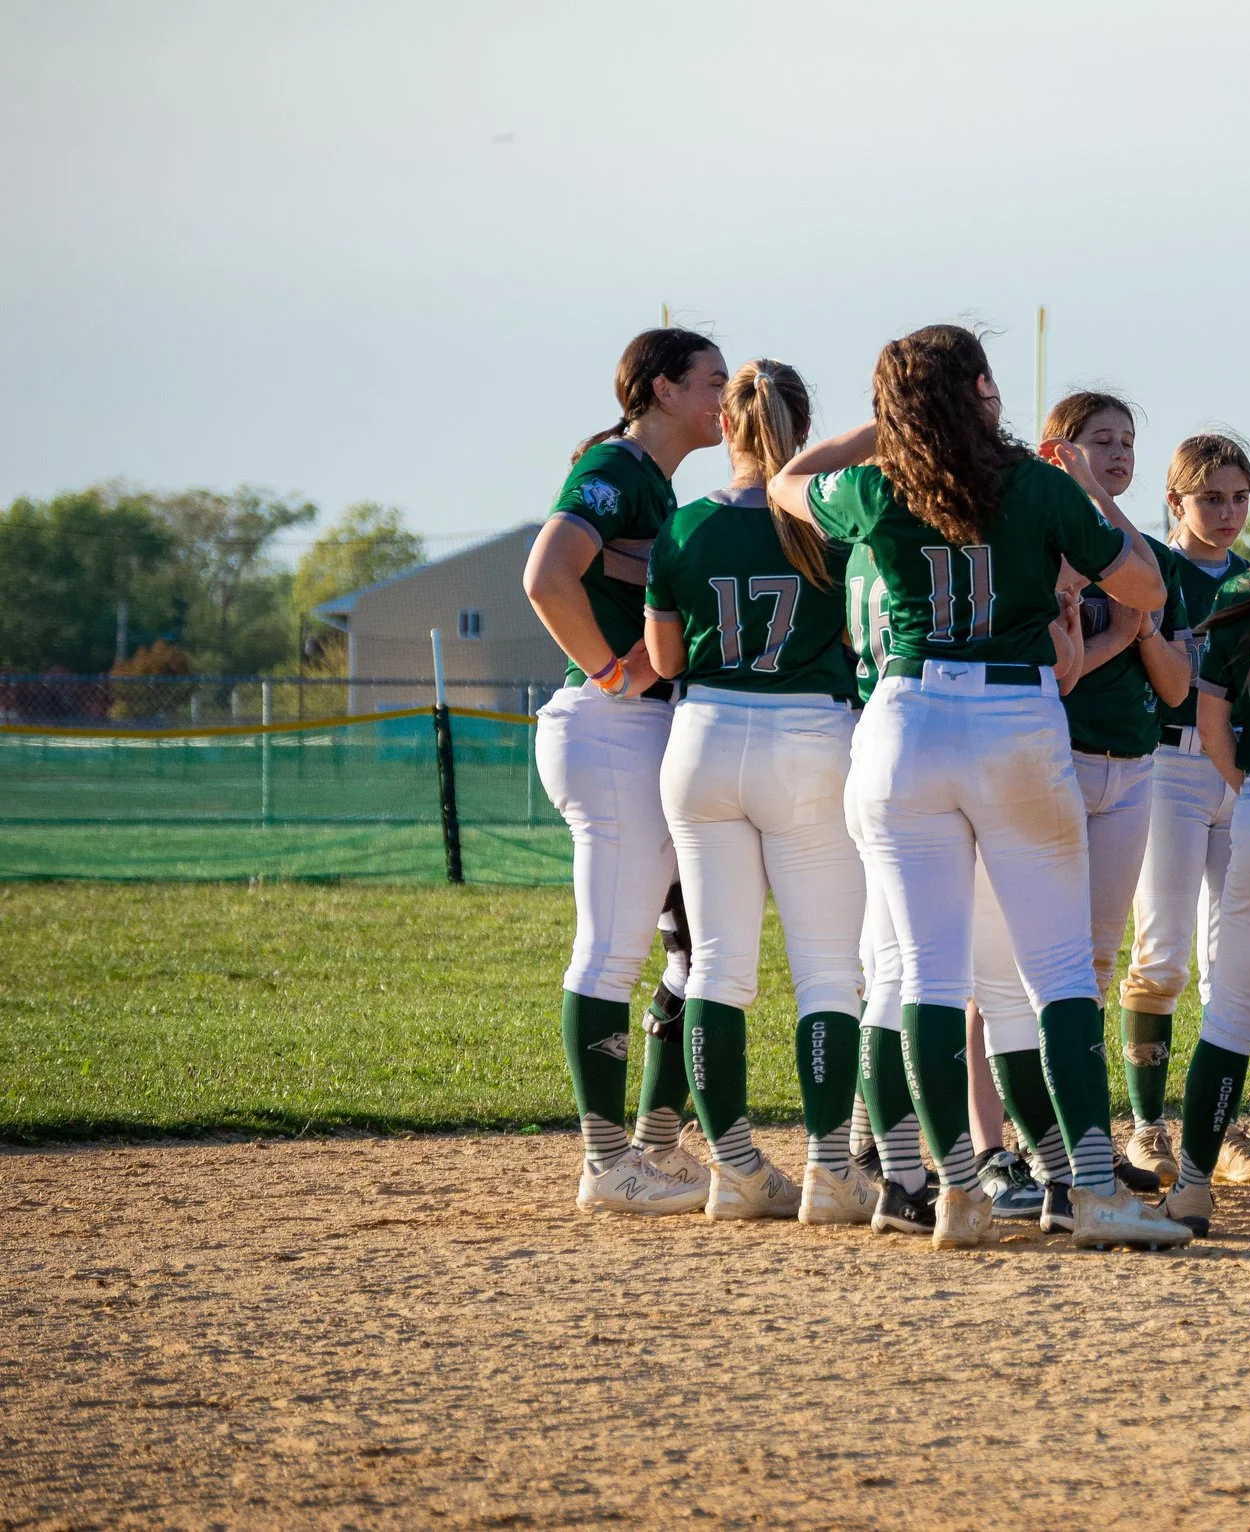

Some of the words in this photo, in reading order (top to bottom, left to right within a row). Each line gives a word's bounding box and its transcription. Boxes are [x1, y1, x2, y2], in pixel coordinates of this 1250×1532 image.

[708, 575, 800, 672] 17
[921, 545, 996, 642] 11
[691, 1027, 706, 1090] COUGARS
[812, 1022, 825, 1083] COUGARS
[860, 1028, 872, 1080] OUGARS
[900, 1029, 921, 1100] COUGARS
[1212, 1077, 1233, 1132] COUGARS
